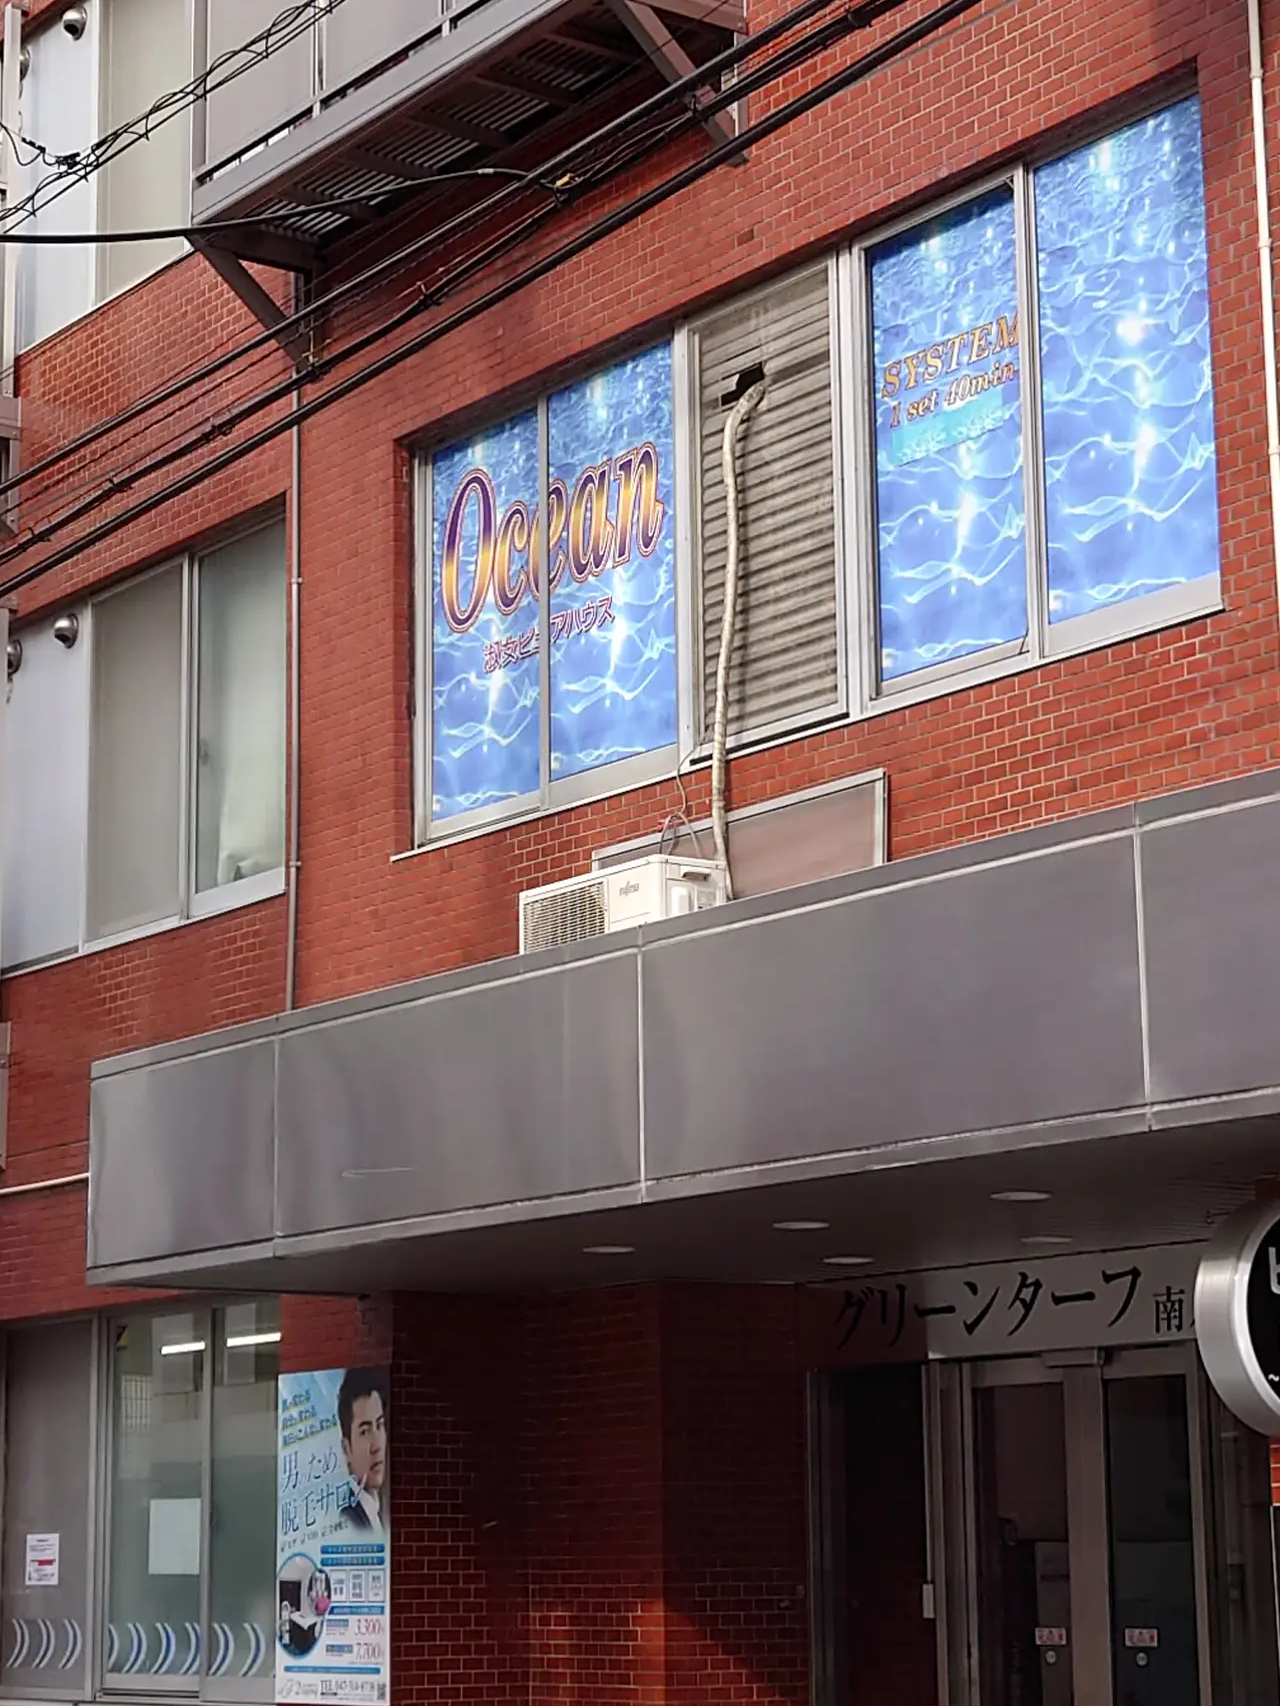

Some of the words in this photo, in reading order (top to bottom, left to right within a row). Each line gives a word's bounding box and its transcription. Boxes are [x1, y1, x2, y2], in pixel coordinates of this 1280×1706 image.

[881, 310, 1020, 398] SYSTEM
[906, 389, 940, 422] set
[944, 361, 1017, 407] 40min
[442, 441, 664, 633] Ocean
[835, 1265, 1142, 1350] グリーンターフ
